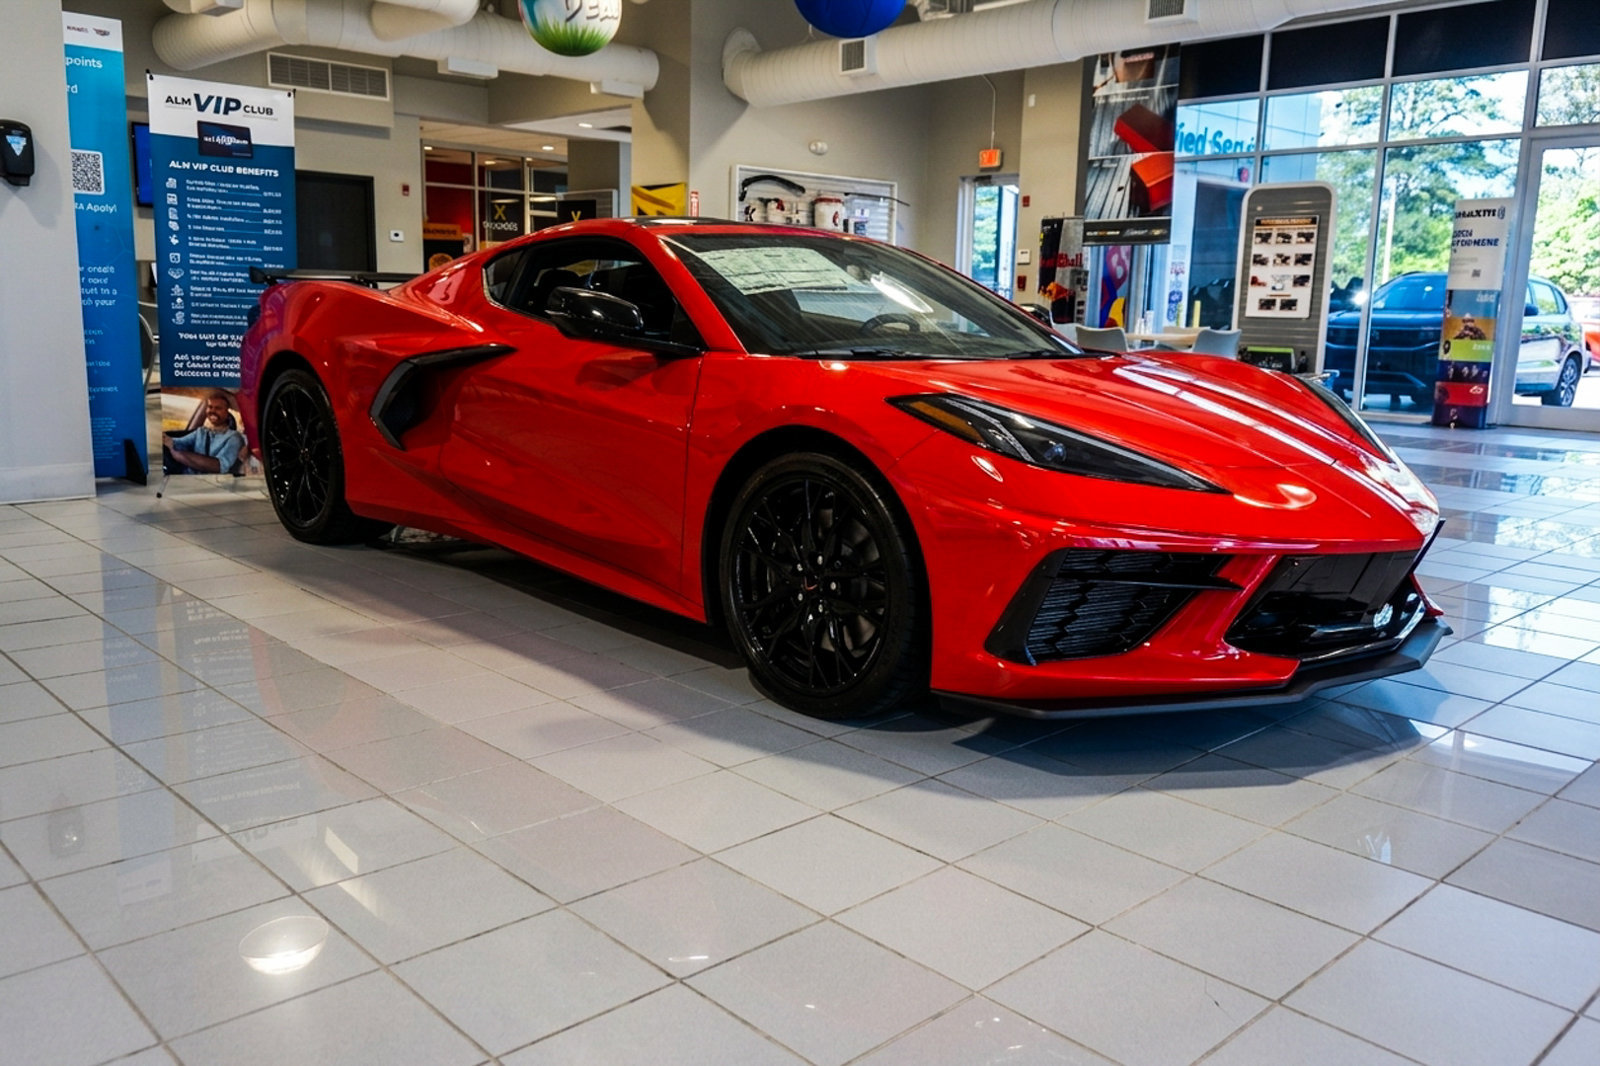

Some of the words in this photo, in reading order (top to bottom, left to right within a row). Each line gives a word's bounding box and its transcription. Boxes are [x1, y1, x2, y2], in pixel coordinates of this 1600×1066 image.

[66, 56, 103, 69] points
[165, 95, 192, 106] ALM
[193, 93, 242, 116] VIP
[243, 105, 274, 116] CLUB
[192, 162, 208, 171] VIP
[236, 167, 279, 177] BENEFITS
